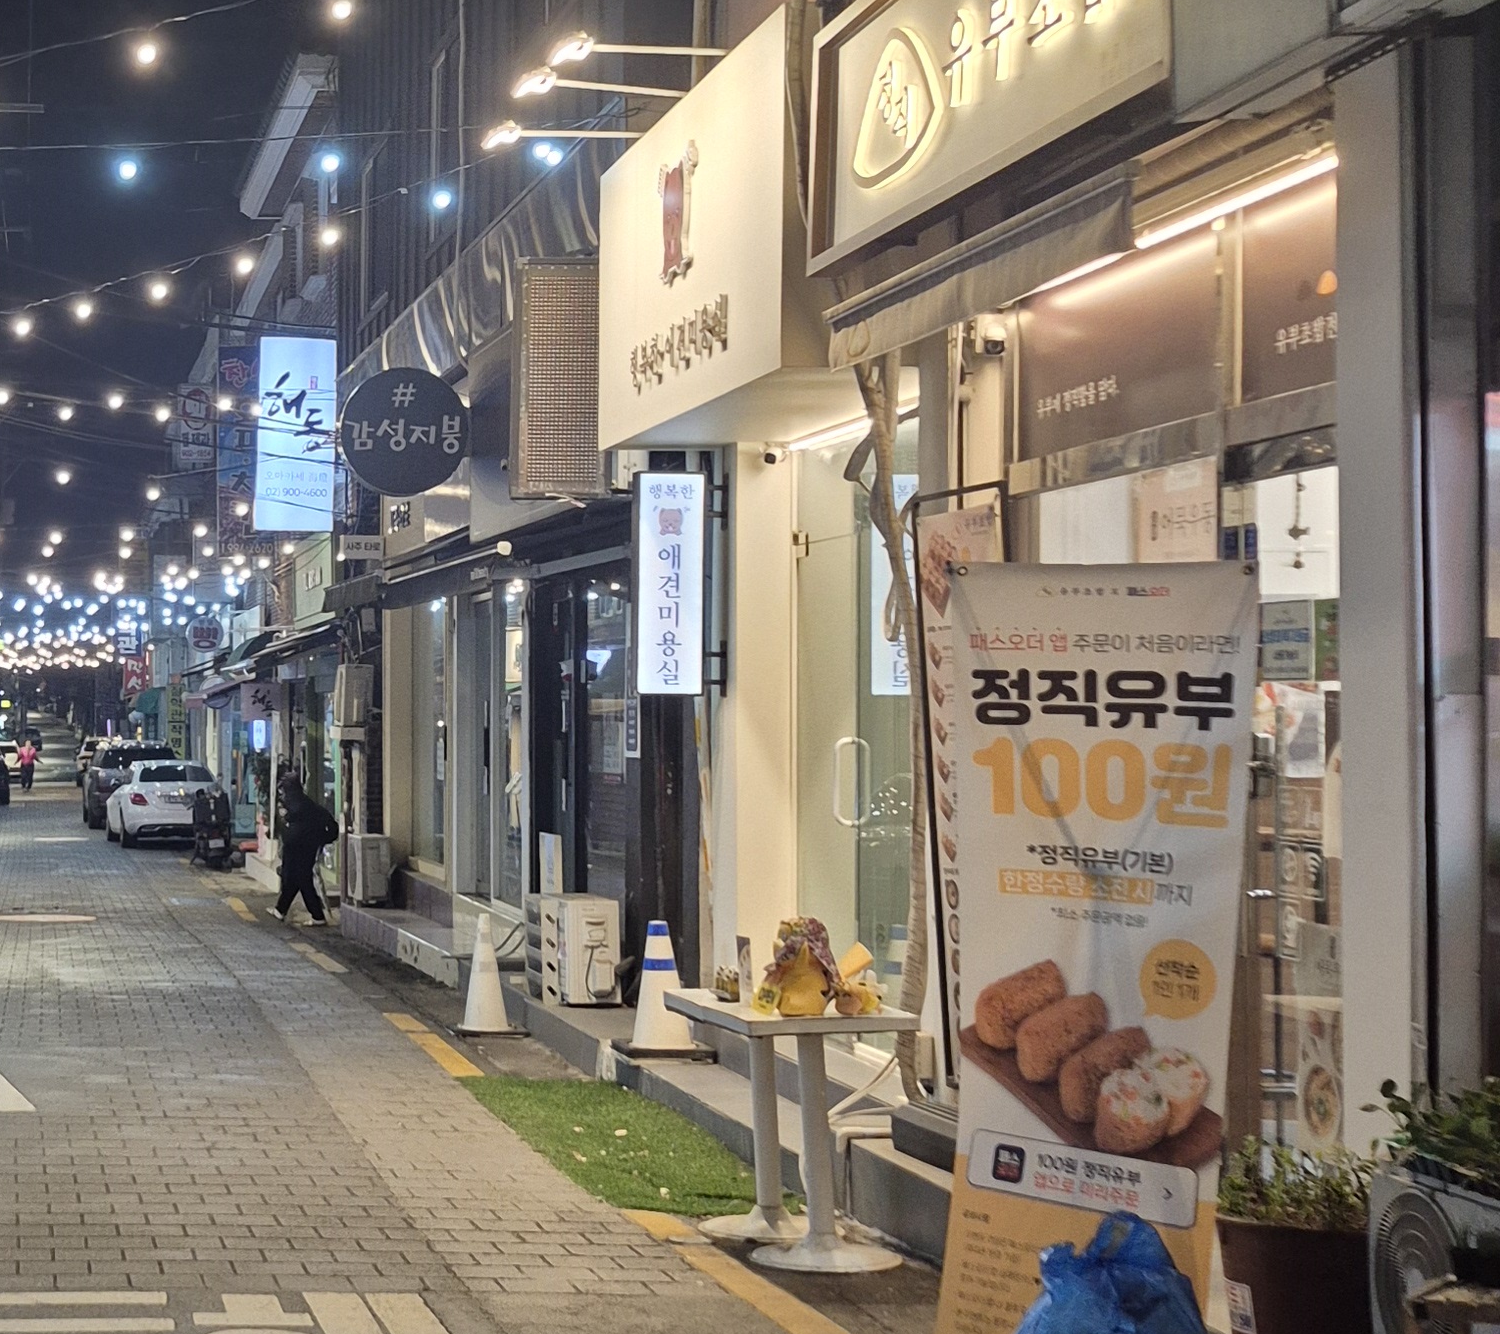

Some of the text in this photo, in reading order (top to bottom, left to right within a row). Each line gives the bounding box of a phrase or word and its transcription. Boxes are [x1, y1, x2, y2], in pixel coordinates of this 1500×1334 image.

[391, 383, 417, 407] #
[344, 415, 462, 455] 감성지붕
[648, 483, 696, 501] 행복한
[655, 542, 683, 686] 애견미용실
[969, 633, 1045, 653] 패스오더
[1050, 632, 1068, 653] 앱
[1072, 633, 1131, 654] 주문이
[971, 667, 1236, 731] 정직유부
[971, 735, 1234, 829] 100원
